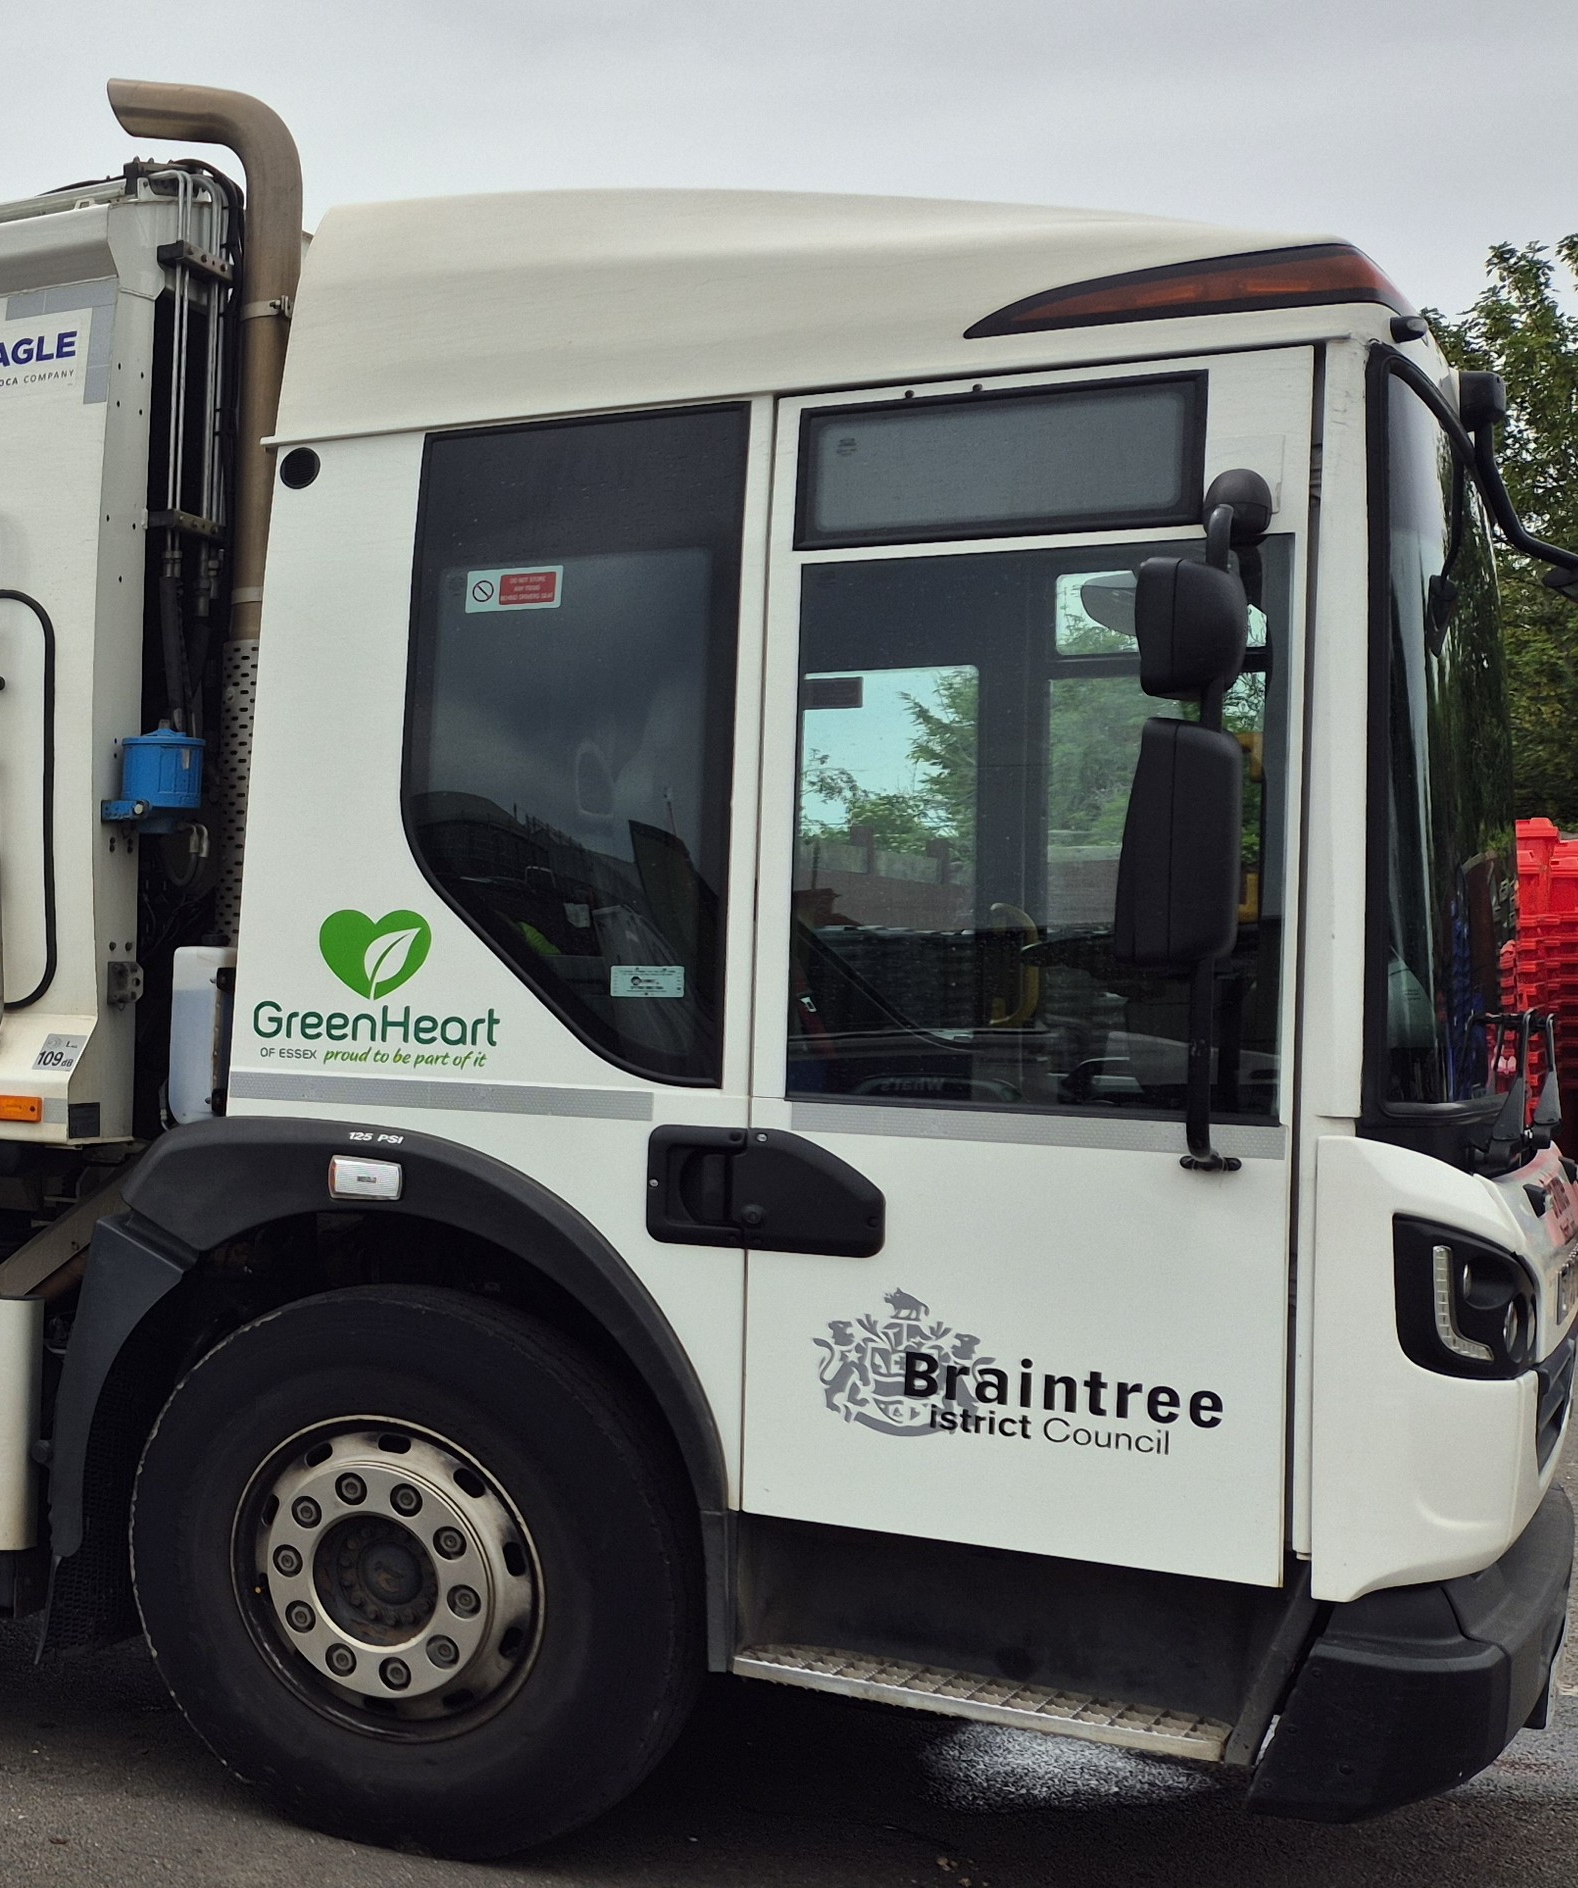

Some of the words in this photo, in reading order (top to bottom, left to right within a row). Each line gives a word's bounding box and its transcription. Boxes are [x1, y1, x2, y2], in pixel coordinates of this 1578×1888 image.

[23, 369, 75, 385] COMPANY
[253, 1000, 501, 1047] GreenHeart
[37, 1050, 64, 1067] 109
[60, 1058, 74, 1067] dB
[260, 1047, 275, 1058] OF
[279, 1048, 317, 1060] ESSEX
[323, 1046, 372, 1065] proud
[372, 1049, 390, 1063] to
[392, 1047, 411, 1065] be
[413, 1051, 450, 1070] part
[452, 1050, 474, 1070] of
[473, 1051, 488, 1067] it
[349, 1131, 373, 1141] 125
[377, 1133, 404, 1145] PSI
[903, 1350, 1224, 1430] Braintree
[1042, 1415, 1171, 1456] Council
